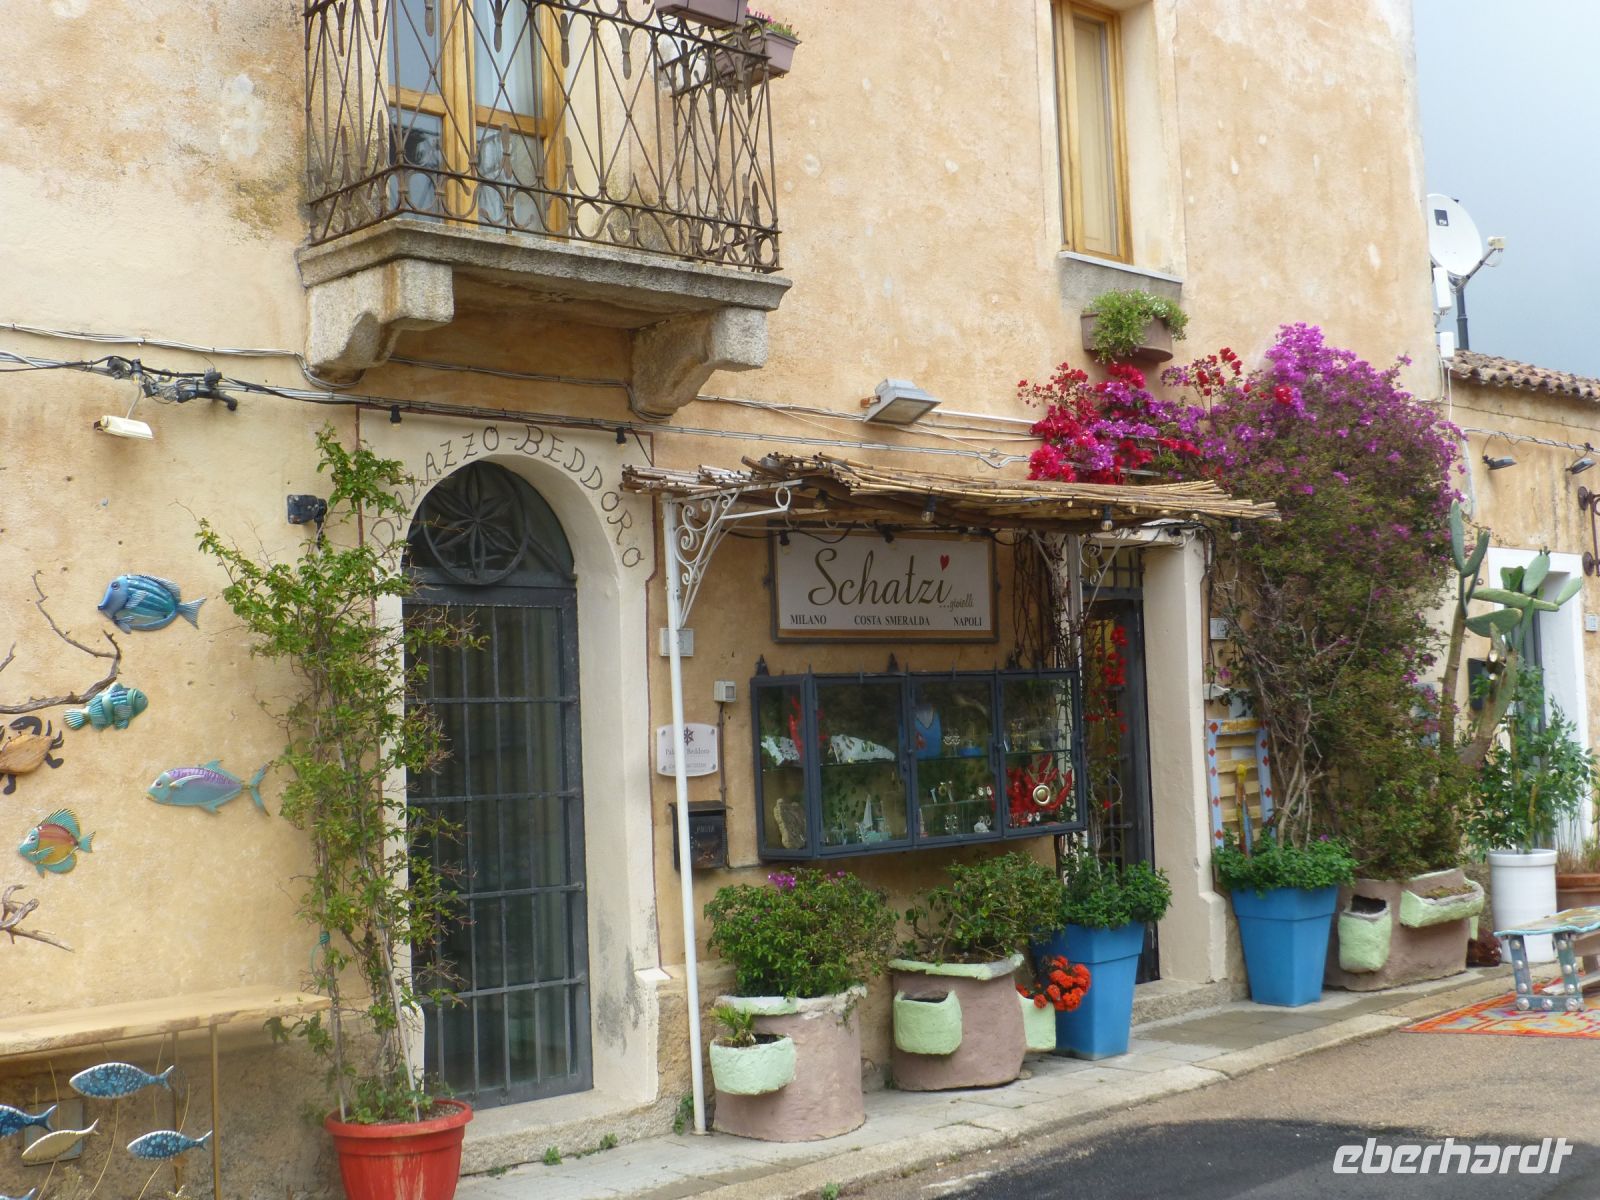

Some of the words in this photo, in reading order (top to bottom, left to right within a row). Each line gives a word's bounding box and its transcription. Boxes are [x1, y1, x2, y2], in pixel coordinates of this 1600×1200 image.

[808, 547, 953, 606] Schatzi
[790, 614, 827, 626] MILANO
[854, 614, 882, 626] COSTA
[885, 615, 930, 627] SMERALDA
[953, 616, 983, 627] NAPOLI
